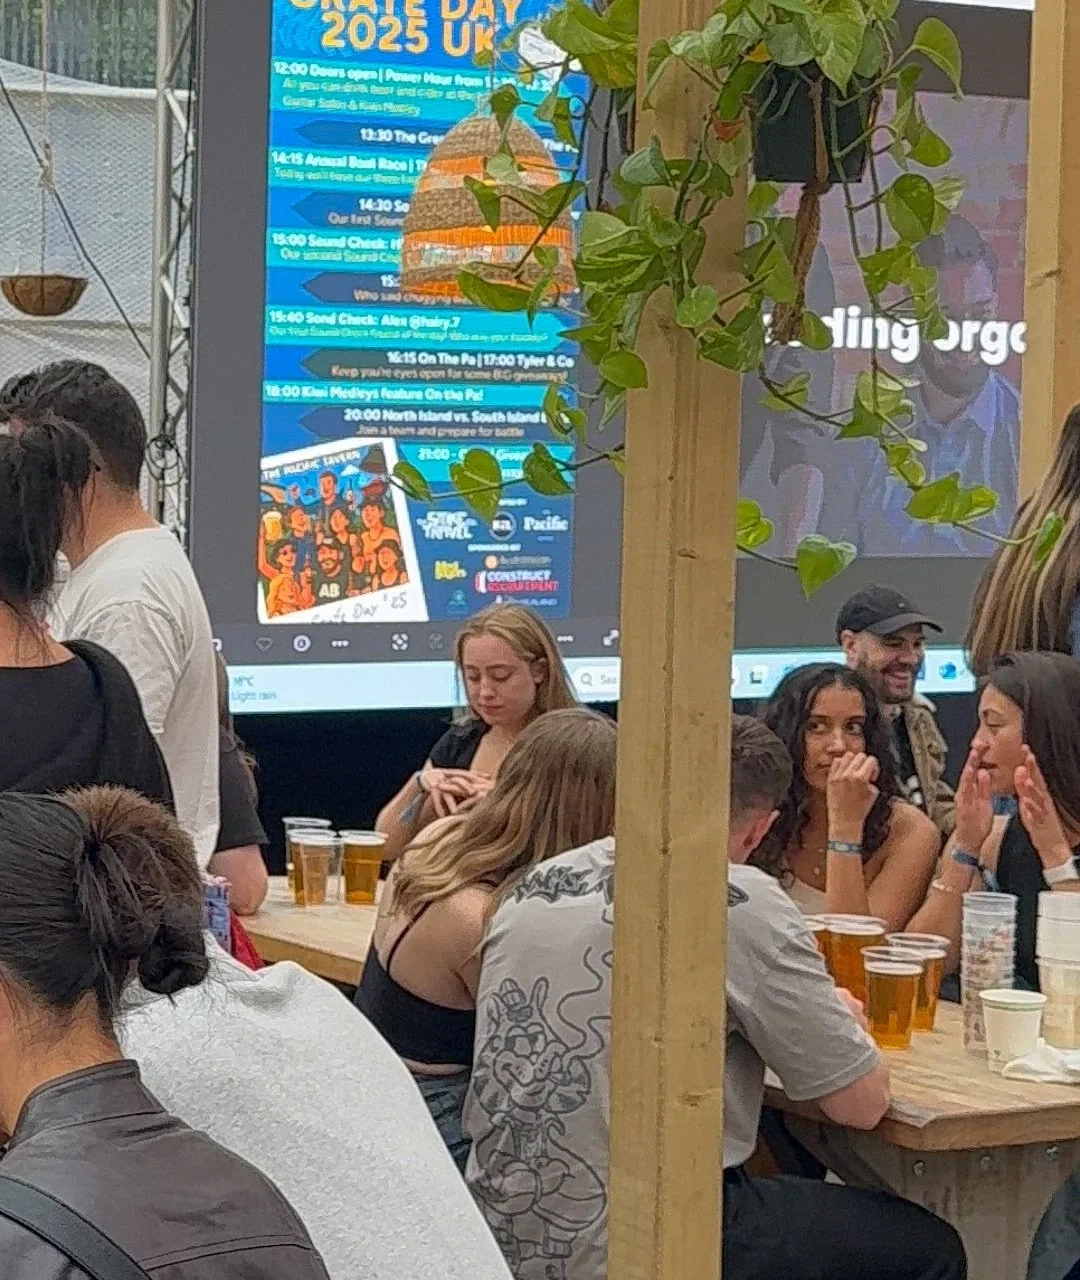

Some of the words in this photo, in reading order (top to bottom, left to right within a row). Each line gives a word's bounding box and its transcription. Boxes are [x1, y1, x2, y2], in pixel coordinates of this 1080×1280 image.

[322, 11, 428, 54] 2025
[443, 20, 496, 57] UK
[274, 62, 308, 75] 12:00
[347, 69, 377, 81] open
[455, 74, 483, 87] from
[360, 128, 393, 142] 13:30
[394, 130, 416, 144] The
[418, 351, 437, 365] On
[437, 352, 460, 365] The
[483, 353, 516, 367] 17:00
[546, 355, 557, 367] &
[331, 365, 360, 378] Keep
[344, 408, 381, 421] 20:00
[382, 409, 418, 422] North
[418, 410, 453, 423] Island
[454, 412, 470, 423] vs.
[471, 410, 506, 423] South
[507, 411, 540, 424] Island
[417, 426, 437, 436] and
[523, 515, 568, 531] Pacific
